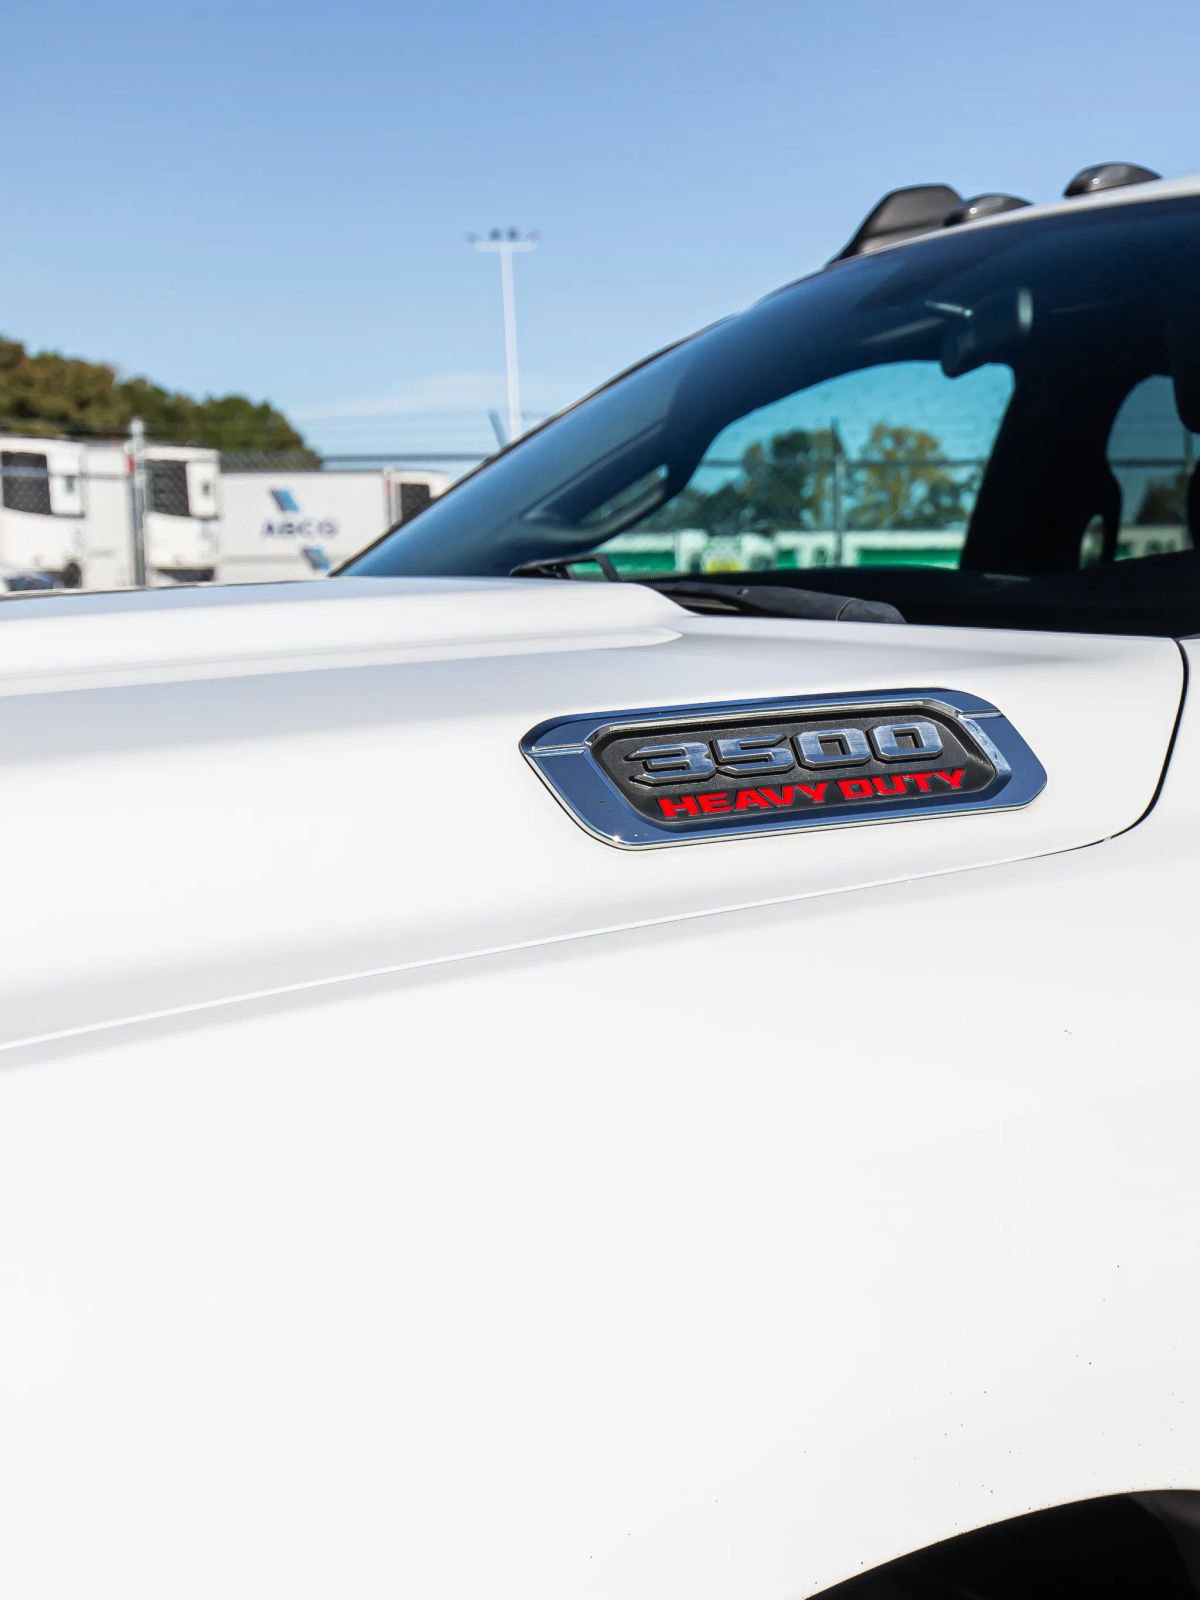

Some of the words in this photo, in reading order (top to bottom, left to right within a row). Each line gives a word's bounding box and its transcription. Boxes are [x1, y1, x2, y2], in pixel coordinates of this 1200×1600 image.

[626, 720, 946, 784] 3500
[659, 782, 830, 818] HEAVY
[839, 770, 967, 799] DUTY
